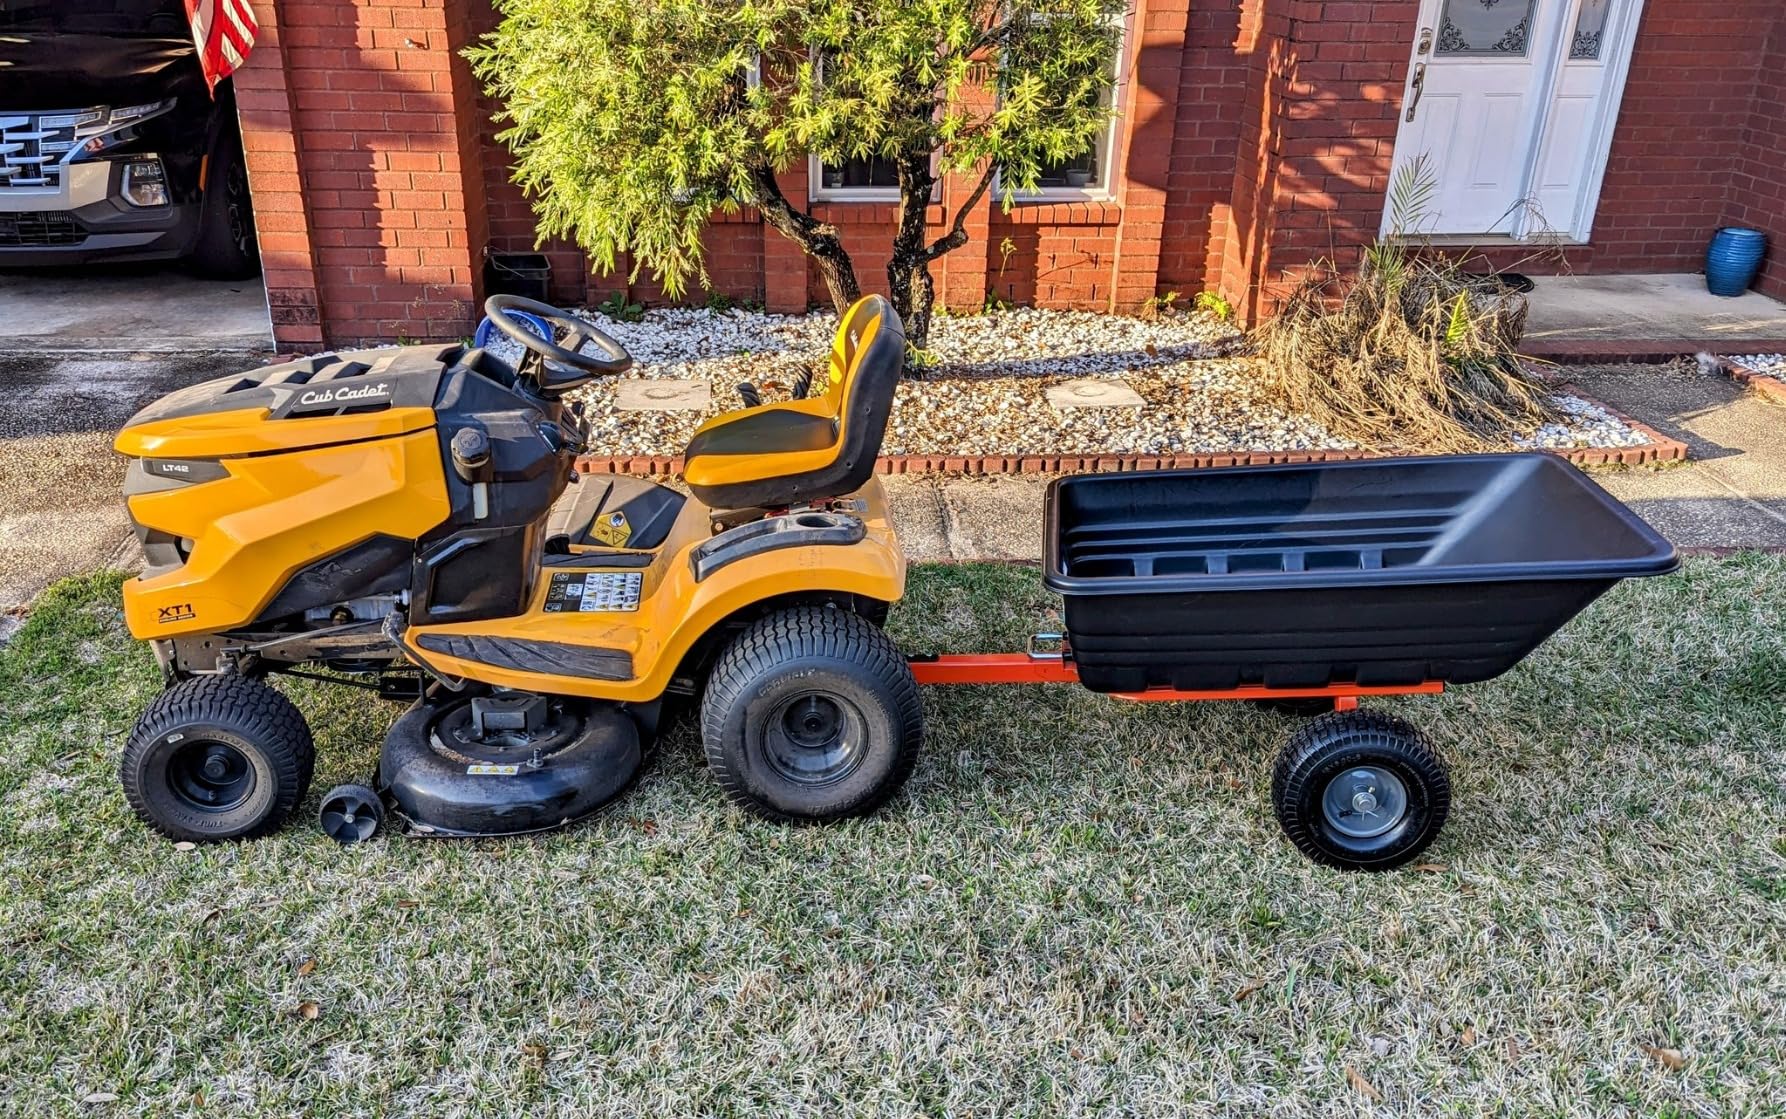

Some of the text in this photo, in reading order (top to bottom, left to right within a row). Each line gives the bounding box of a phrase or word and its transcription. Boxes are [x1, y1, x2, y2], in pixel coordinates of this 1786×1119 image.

[301, 383, 388, 405] Cub Cadet
[162, 464, 189, 473] LT42
[158, 603, 192, 618] XT1
